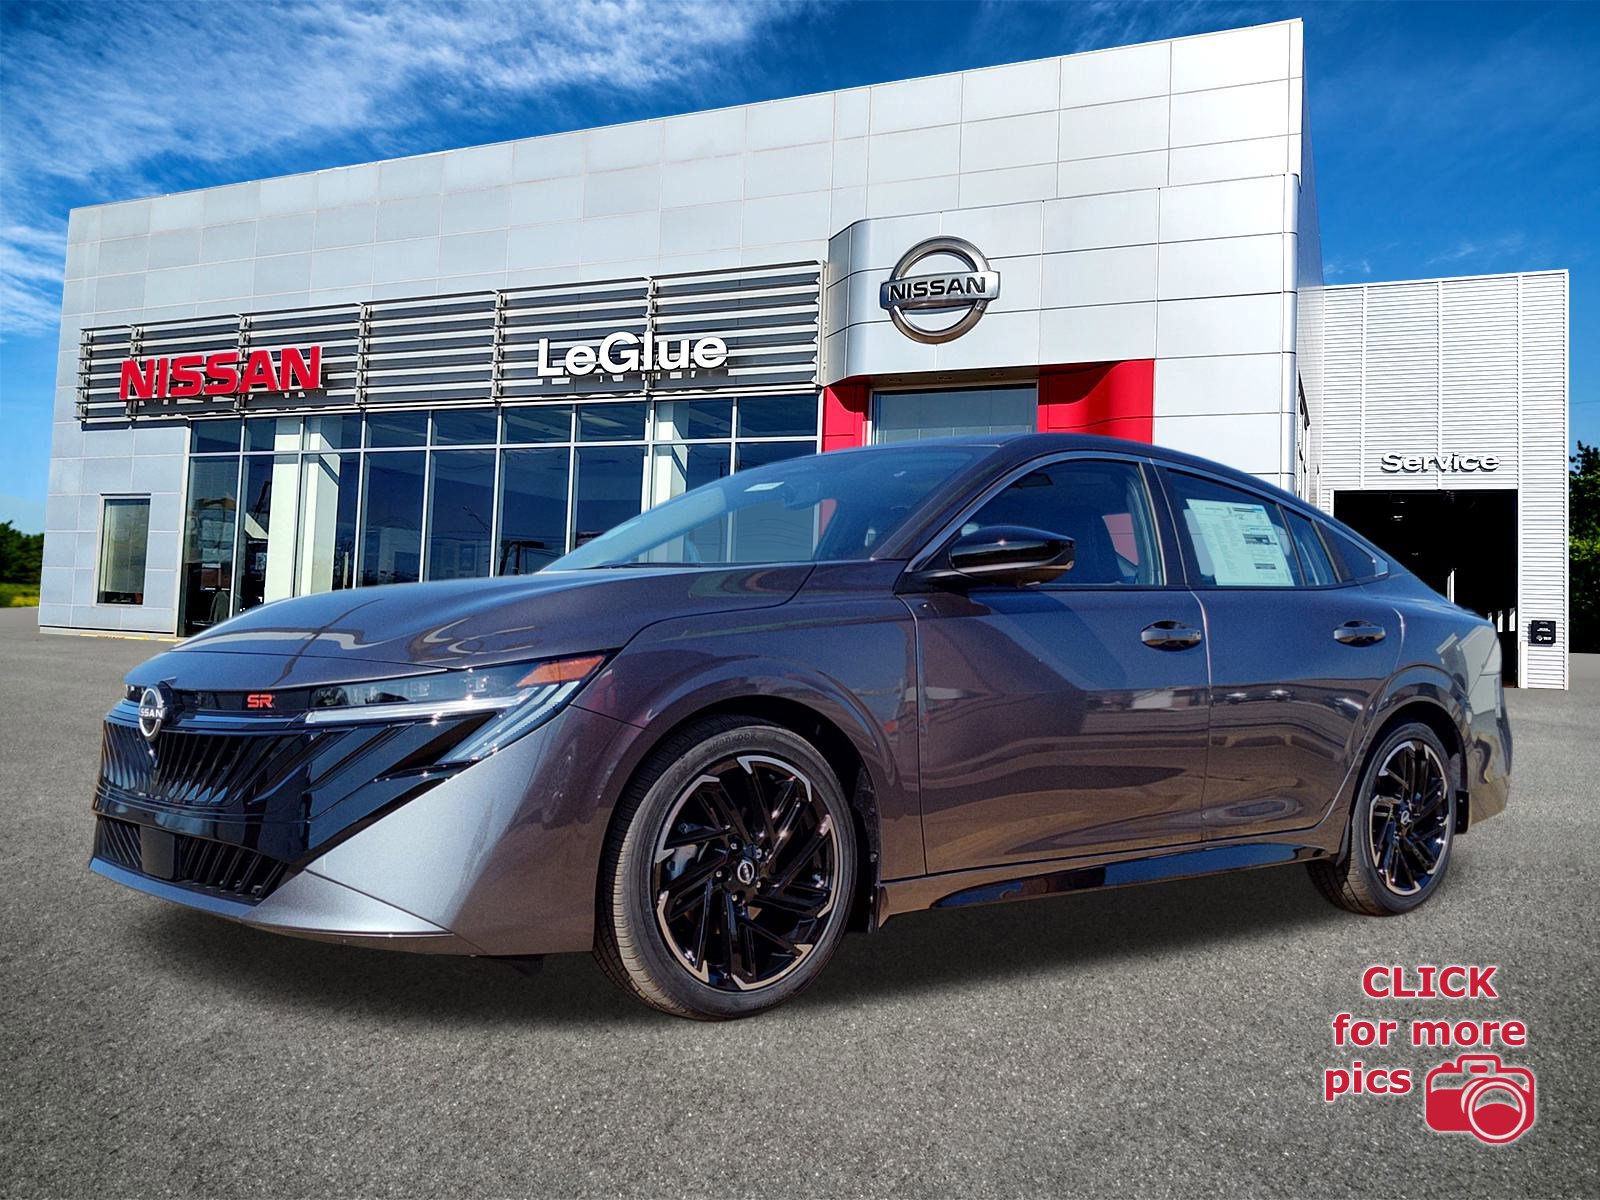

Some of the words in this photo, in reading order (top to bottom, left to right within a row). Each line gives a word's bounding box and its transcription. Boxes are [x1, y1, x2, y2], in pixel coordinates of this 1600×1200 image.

[888, 276, 985, 300] NISSAN
[537, 331, 729, 377] LeGlue
[119, 346, 322, 400] NISSAN
[1381, 451, 1500, 473] Service
[247, 694, 273, 708] SR
